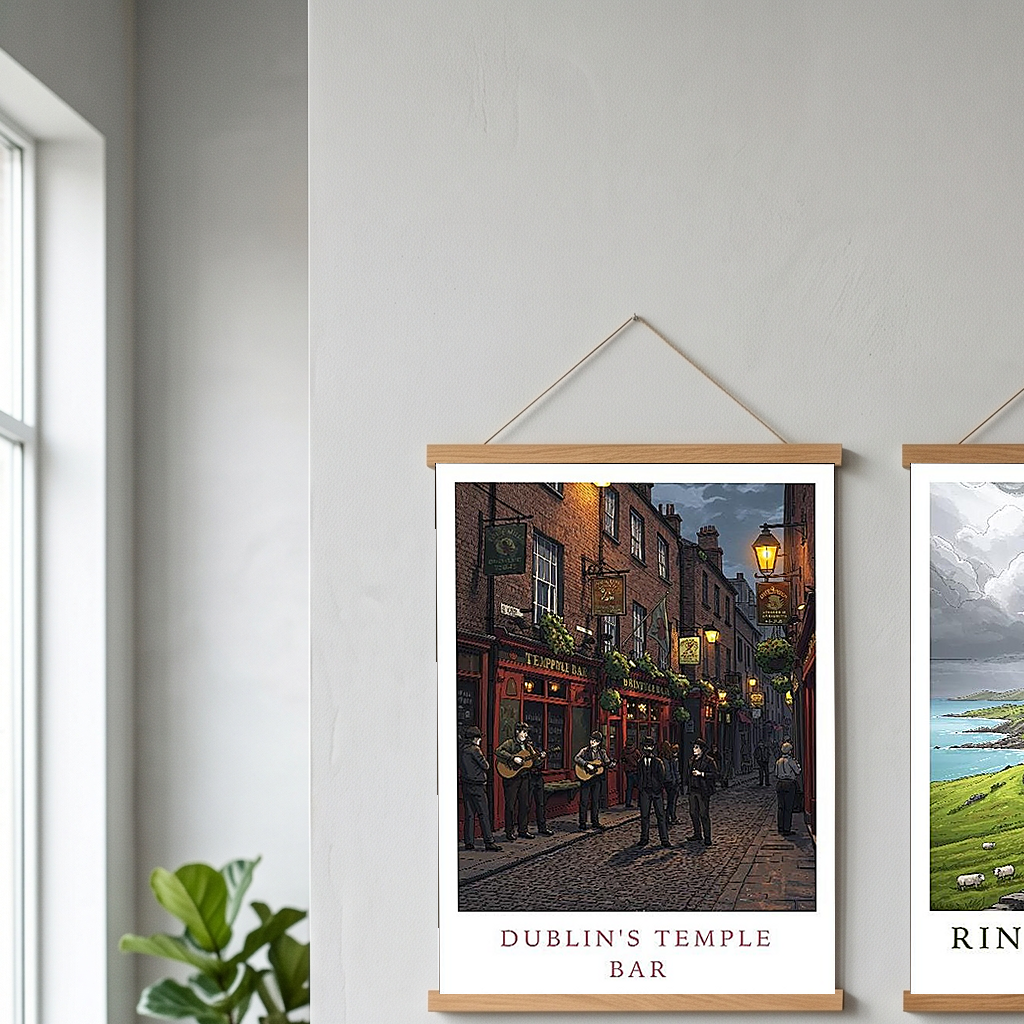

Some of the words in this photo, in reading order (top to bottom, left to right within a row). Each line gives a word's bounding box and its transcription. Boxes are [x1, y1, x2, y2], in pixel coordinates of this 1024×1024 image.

[501, 929, 640, 948] DUBLIN'S
[655, 929, 771, 948] TEMPLE
[609, 960, 667, 978] BAR
